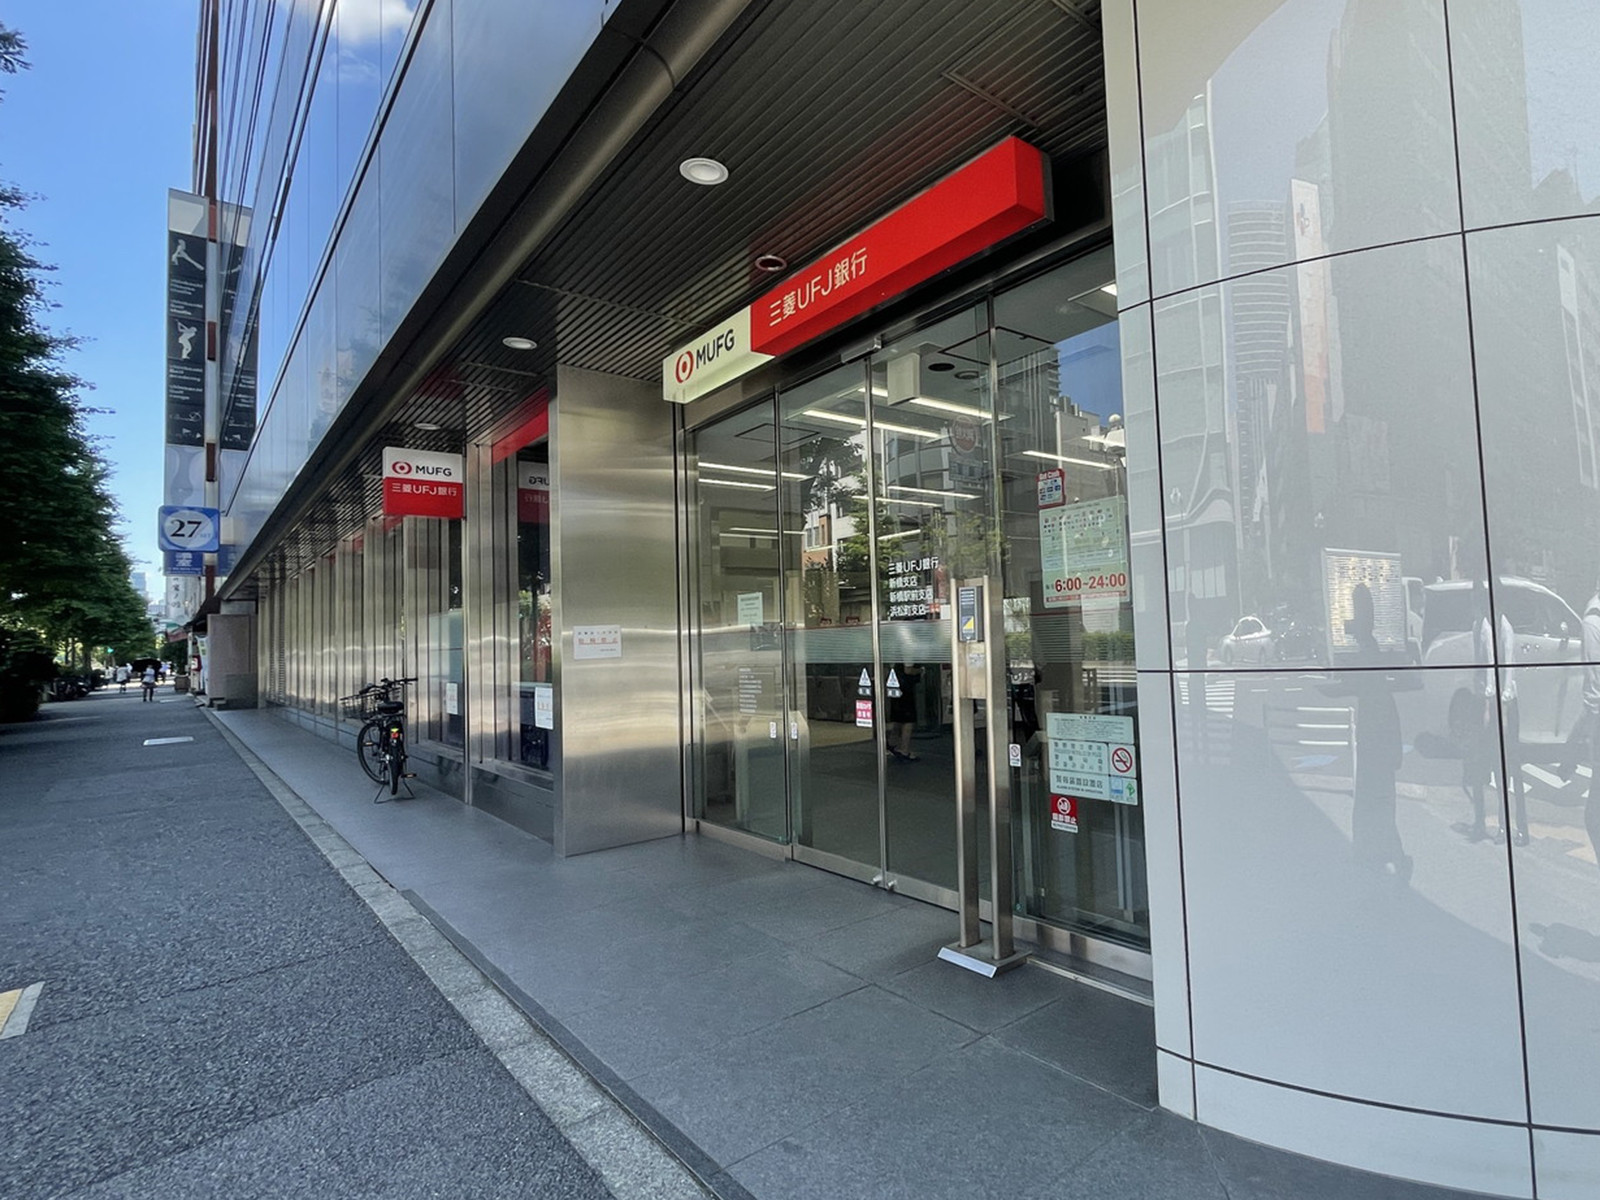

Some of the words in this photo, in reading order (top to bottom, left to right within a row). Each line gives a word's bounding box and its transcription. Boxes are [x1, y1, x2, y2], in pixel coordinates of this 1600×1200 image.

[769, 247, 868, 327] 三菱UFJ銀行
[696, 329, 735, 368] MUFG
[415, 465, 452, 477] MUFG
[392, 482, 457, 497] 三菱UFJ銀行
[170, 519, 202, 538] 27
[888, 556, 939, 575] 三菱UFJ銀行
